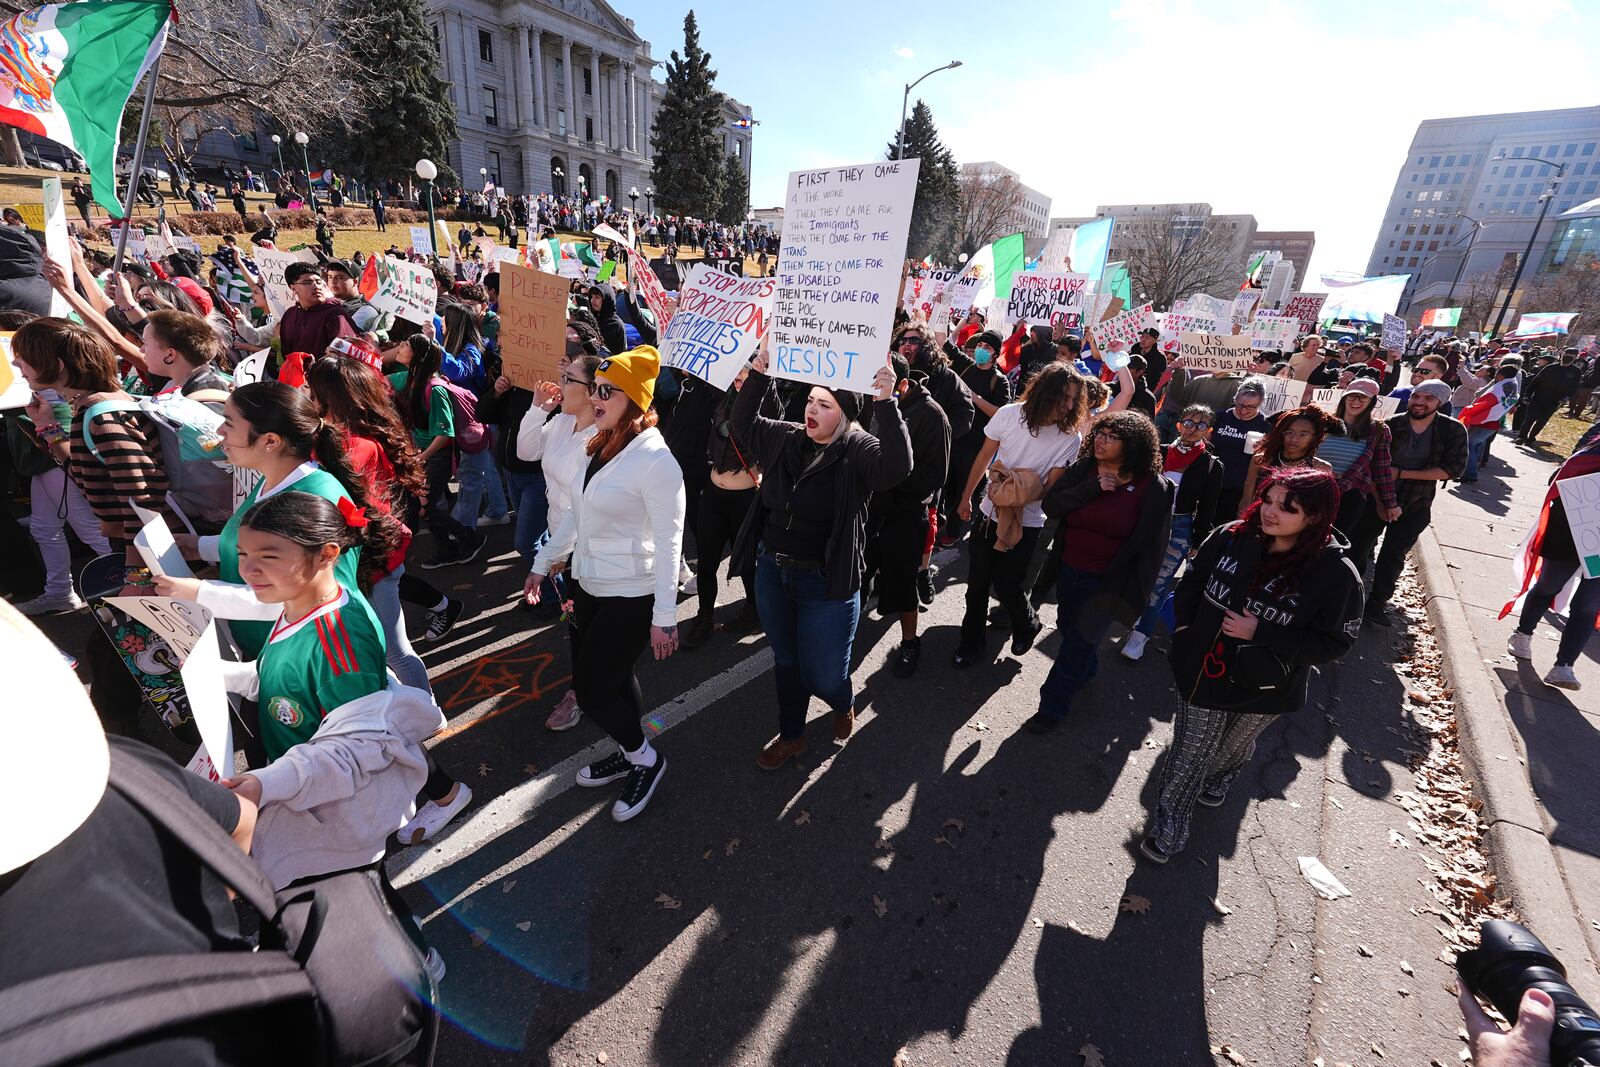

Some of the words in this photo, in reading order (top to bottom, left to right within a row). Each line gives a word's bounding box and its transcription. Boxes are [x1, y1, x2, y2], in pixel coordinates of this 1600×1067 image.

[798, 172, 830, 188] FIRST
[838, 168, 864, 182] THEY
[874, 164, 900, 178] CAME
[804, 191, 820, 204] THE
[824, 190, 844, 198] WOKE
[795, 209, 816, 218] THEN
[820, 206, 840, 218] THEY
[846, 205, 872, 216] CAME
[878, 204, 894, 214] FOR
[790, 222, 804, 230] THE
[809, 219, 860, 234] Immigrants
[788, 233, 806, 242] THEN
[809, 234, 826, 246] THEY
[872, 232, 889, 240] THE
[782, 246, 808, 258] TRANS
[782, 260, 804, 272] THEN
[808, 260, 832, 274] THEY
[834, 260, 862, 272] CAME
[866, 258, 884, 268] FOR
[262, 270, 286, 286] VOZ
[780, 274, 794, 287] THE
[798, 273, 842, 286] DISABLED
[930, 270, 952, 282] YOU
[512, 272, 564, 303] PLEASE
[700, 272, 738, 294] STOP
[730, 280, 776, 298] MASS
[777, 288, 800, 300] THEN
[802, 289, 828, 303] THEY
[830, 290, 858, 304] CAME
[860, 290, 880, 304] FOR
[1292, 296, 1323, 306] MAKE
[776, 301, 794, 315] THE
[798, 302, 817, 316] POC
[1285, 304, 1320, 312] NAZIS
[775, 316, 796, 328] THEN
[800, 318, 826, 334] THEY
[828, 320, 856, 334] CAME
[856, 324, 877, 339] FOR
[1093, 309, 1140, 332] GRITANDO
[1184, 322, 1216, 332] HANDS
[678, 313, 743, 354] FAMILIES
[1098, 318, 1145, 340] NUESTROS
[774, 332, 790, 344] THE
[795, 334, 830, 348] WOMEN
[350, 344, 372, 366] VIVA
[1181, 344, 1252, 358] ISOLATIONISM
[776, 346, 860, 378] RESIST
[1184, 356, 1218, 368] HURTS
[1220, 360, 1234, 370] US
[1273, 378, 1289, 394] THE
[1317, 390, 1333, 400] NO
[1225, 424, 1238, 433] I'm
[1206, 574, 1294, 626] DAVSON
